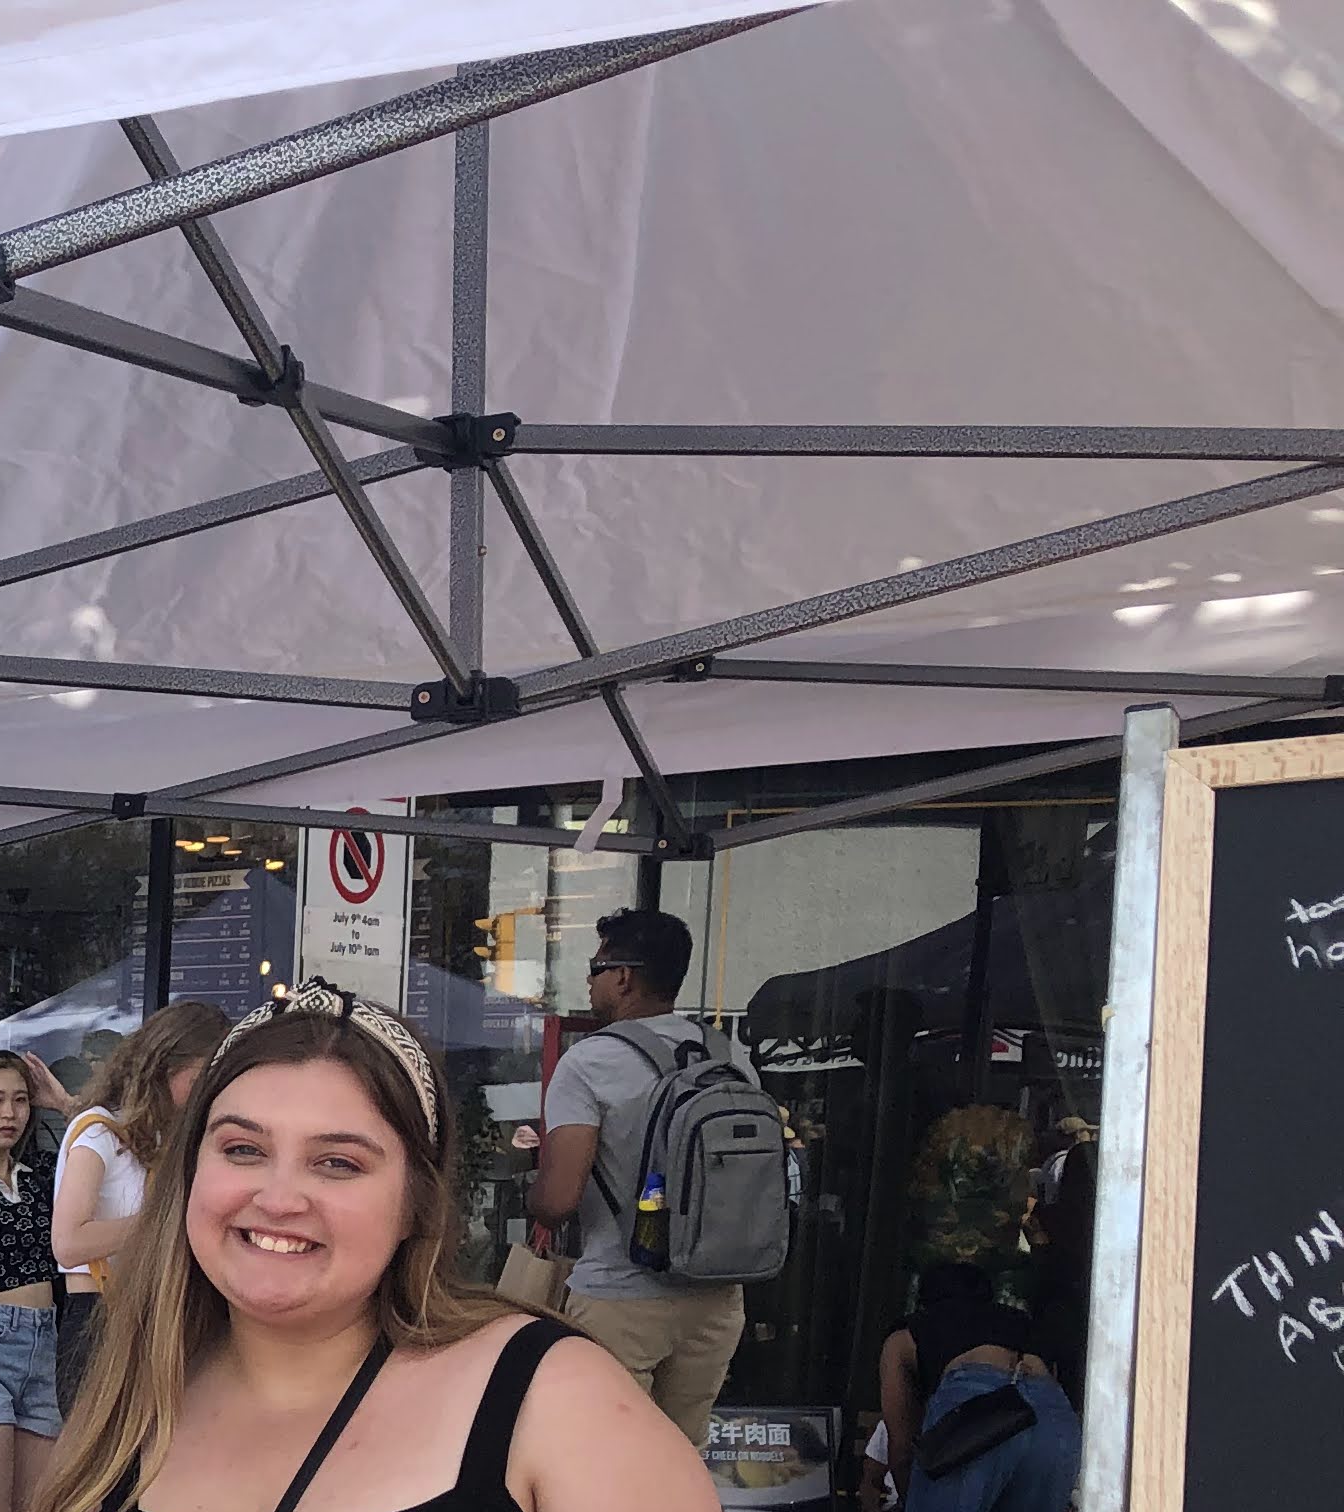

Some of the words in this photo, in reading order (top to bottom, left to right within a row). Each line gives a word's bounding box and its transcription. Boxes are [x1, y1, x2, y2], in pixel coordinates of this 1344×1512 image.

[333, 912, 349, 926] July
[352, 929, 360, 940] to
[330, 942, 346, 956] July
